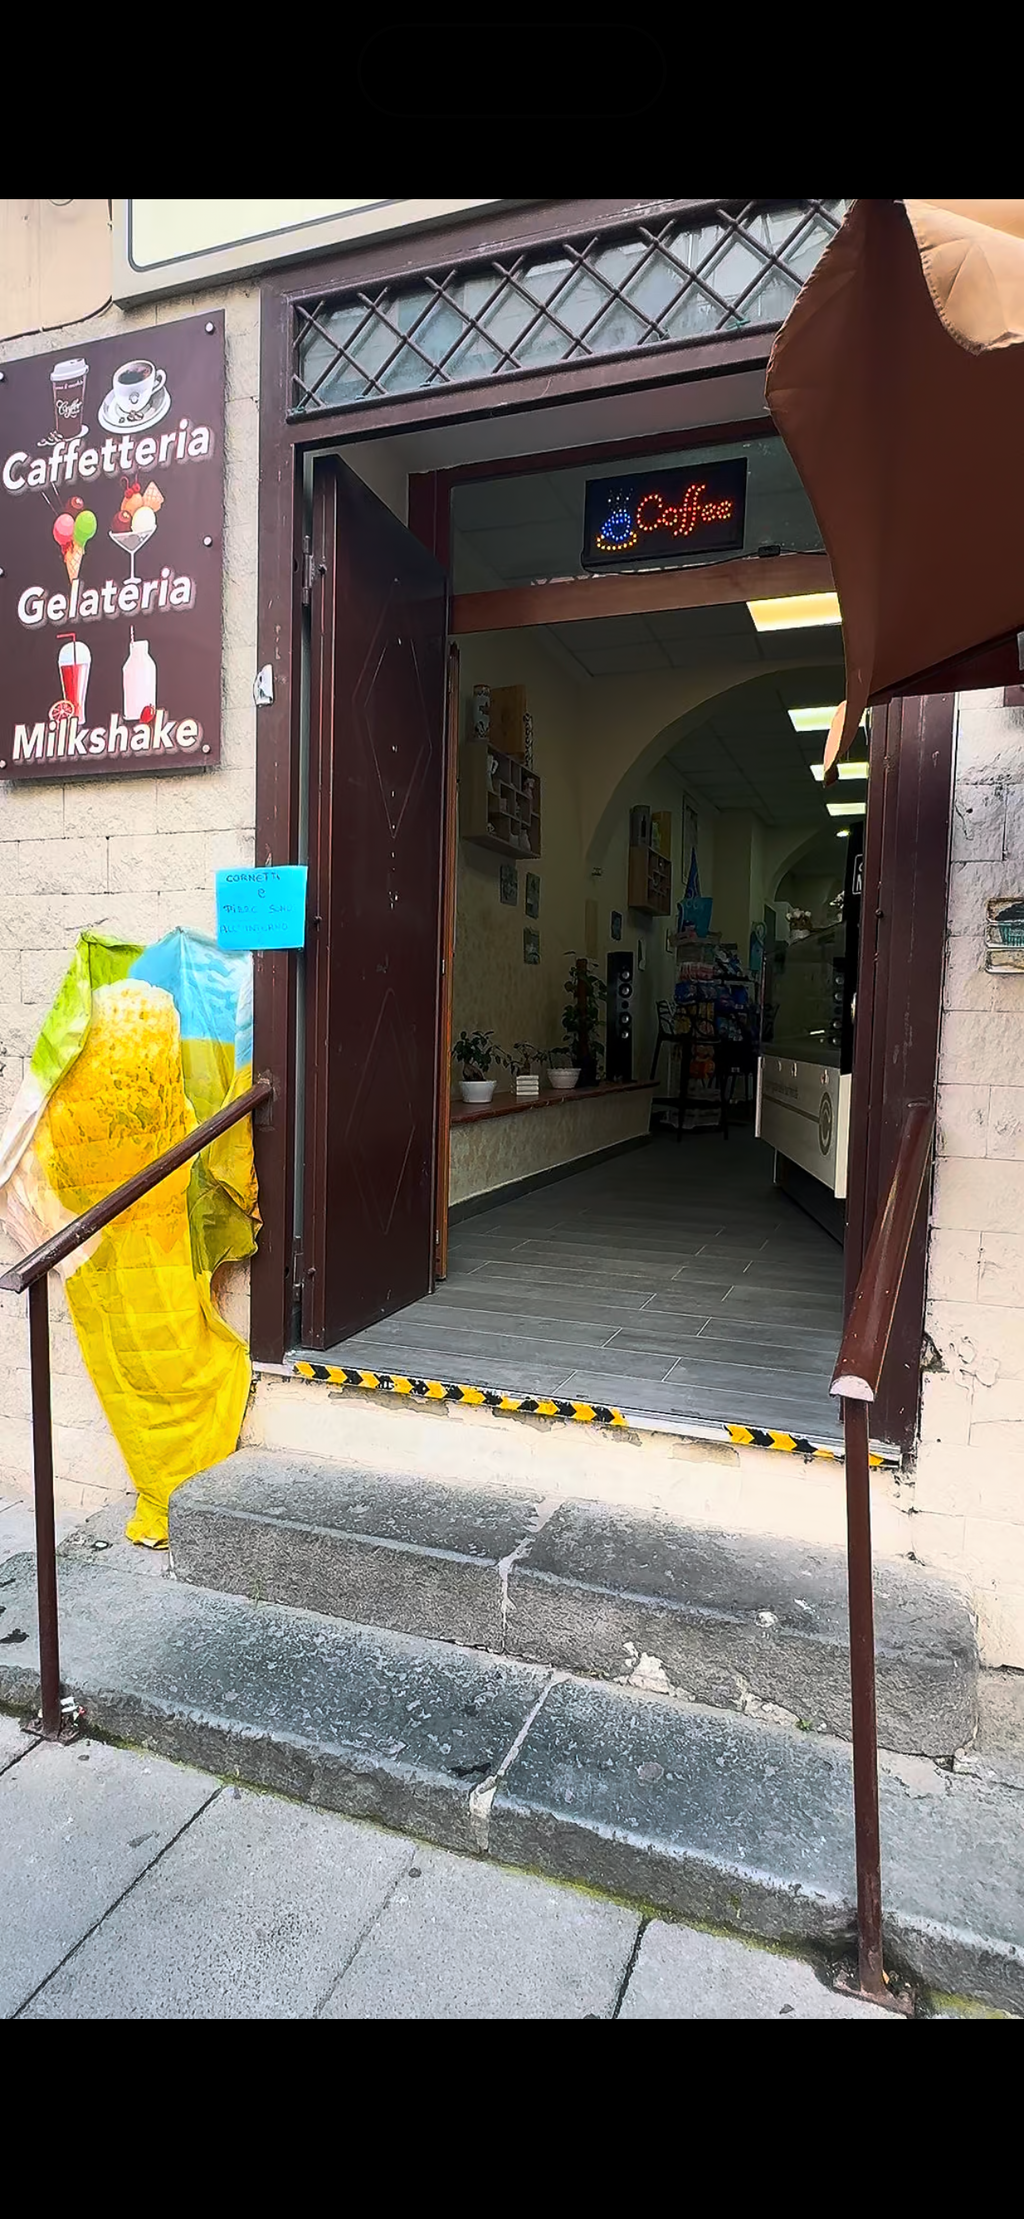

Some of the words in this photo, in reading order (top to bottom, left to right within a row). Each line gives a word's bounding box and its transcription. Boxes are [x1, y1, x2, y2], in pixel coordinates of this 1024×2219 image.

[2, 419, 211, 492] Caffetteria
[636, 484, 733, 537] Coffee
[17, 567, 193, 625] Gelateria
[12, 707, 201, 760] Milkshake
[225, 872, 281, 882] CORNETTI
